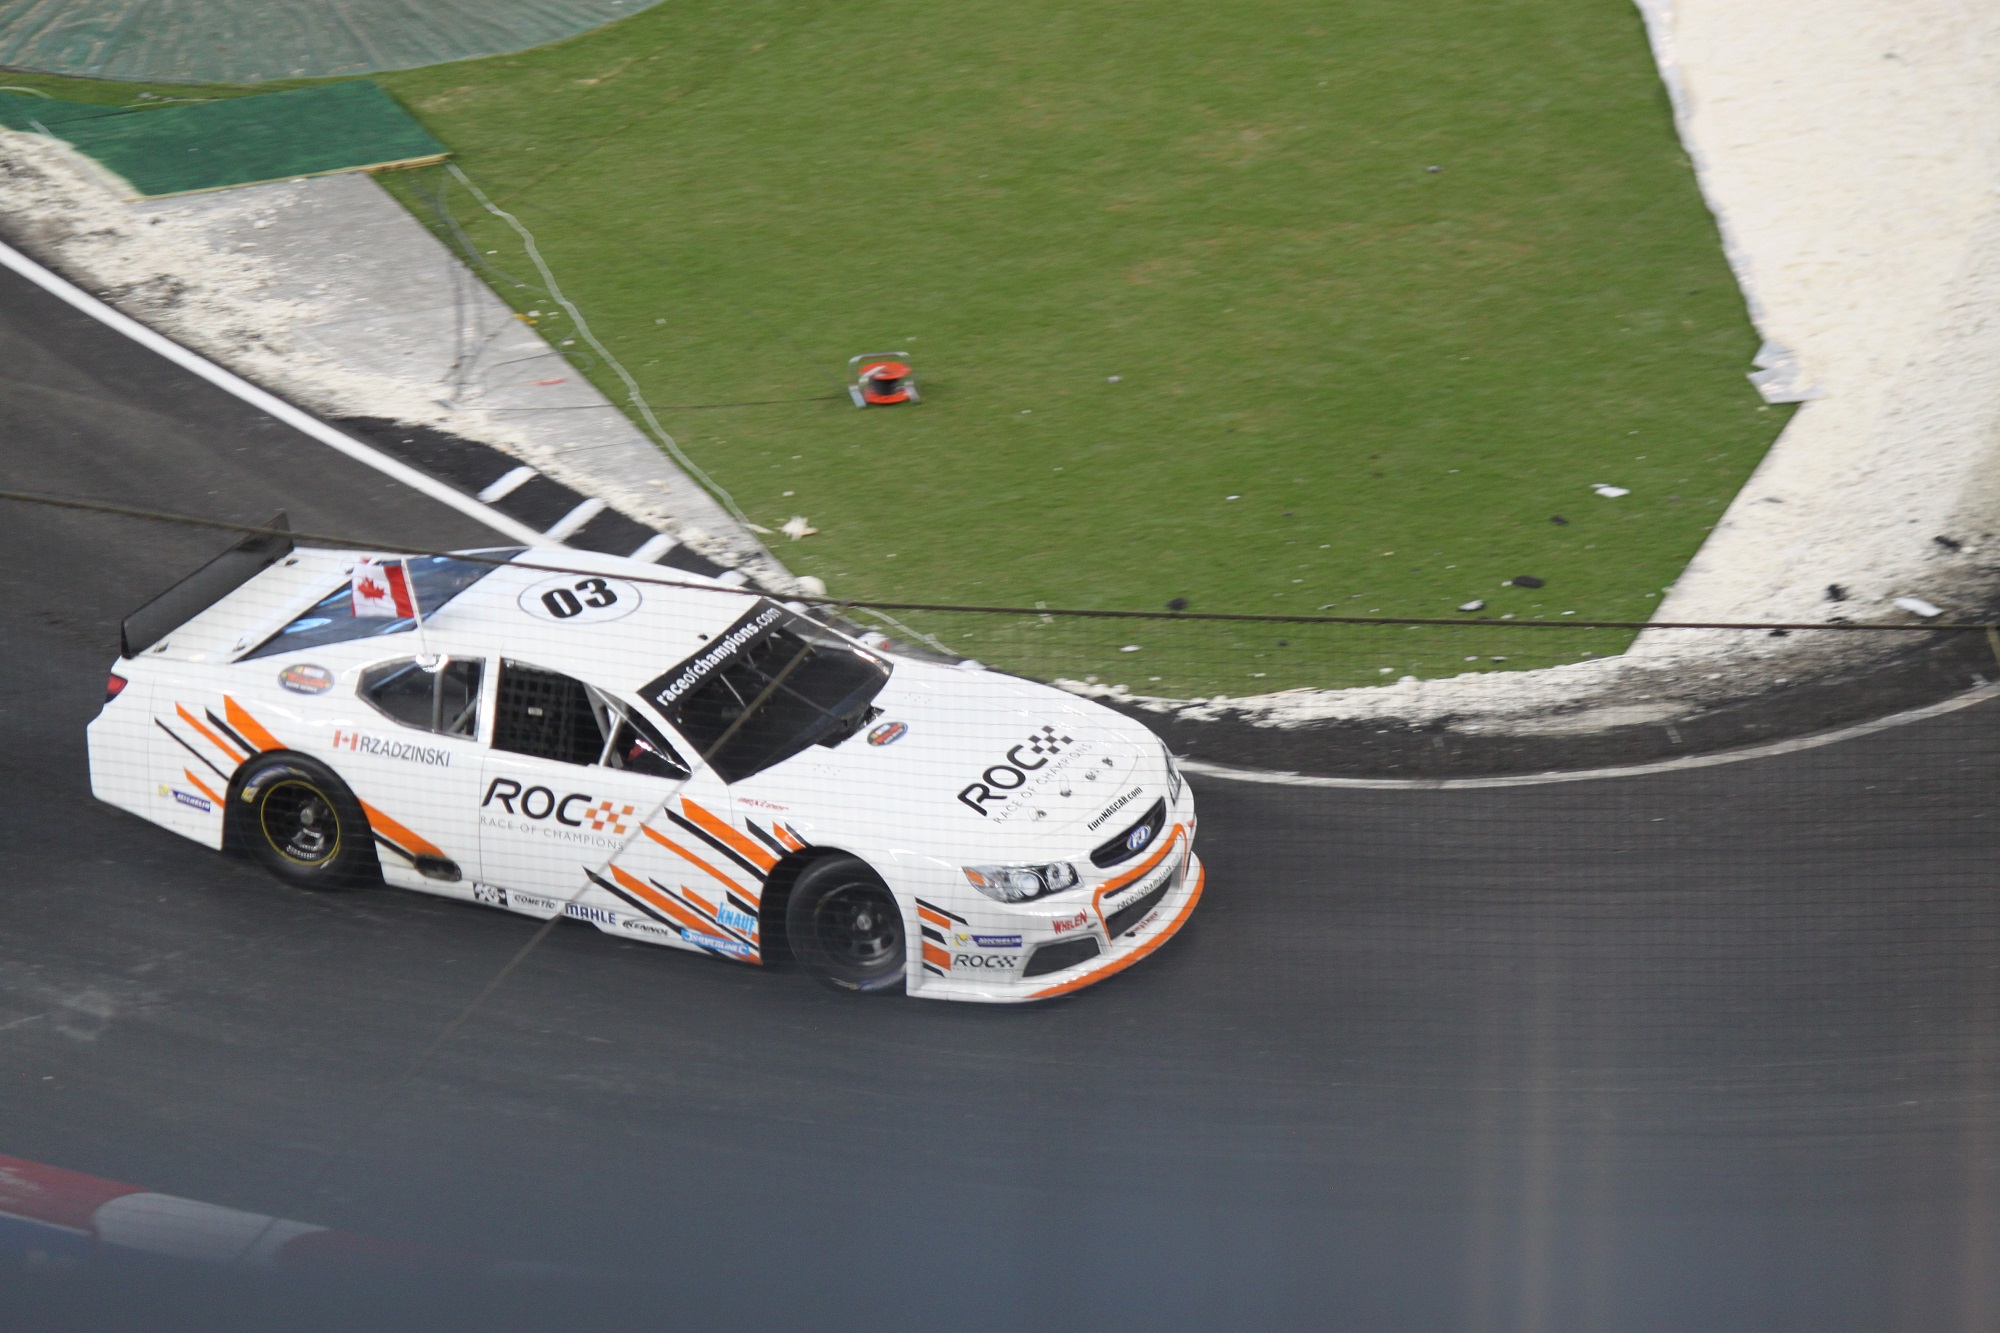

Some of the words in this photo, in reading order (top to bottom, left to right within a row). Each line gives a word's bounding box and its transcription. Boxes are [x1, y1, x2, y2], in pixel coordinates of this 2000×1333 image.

[541, 578, 617, 618] 03
[656, 606, 782, 706] raceofchampions.com
[359, 735, 451, 767] RZADZINSKI
[957, 744, 1048, 817] ROC
[481, 777, 592, 827] ROC
[993, 799, 1024, 825] RACE
[1020, 785, 1038, 800] OF
[1087, 786, 1143, 831] EuroNASCAR.com
[480, 815, 513, 830] RACE
[520, 823, 537, 834] OF
[543, 828, 624, 851] CHAMPIONS
[514, 894, 556, 910] COMETIC
[564, 903, 616, 925] MAHLE
[717, 902, 756, 936] KNAUF
[1052, 908, 1088, 934] WHELEN
[953, 954, 999, 968] ROC
